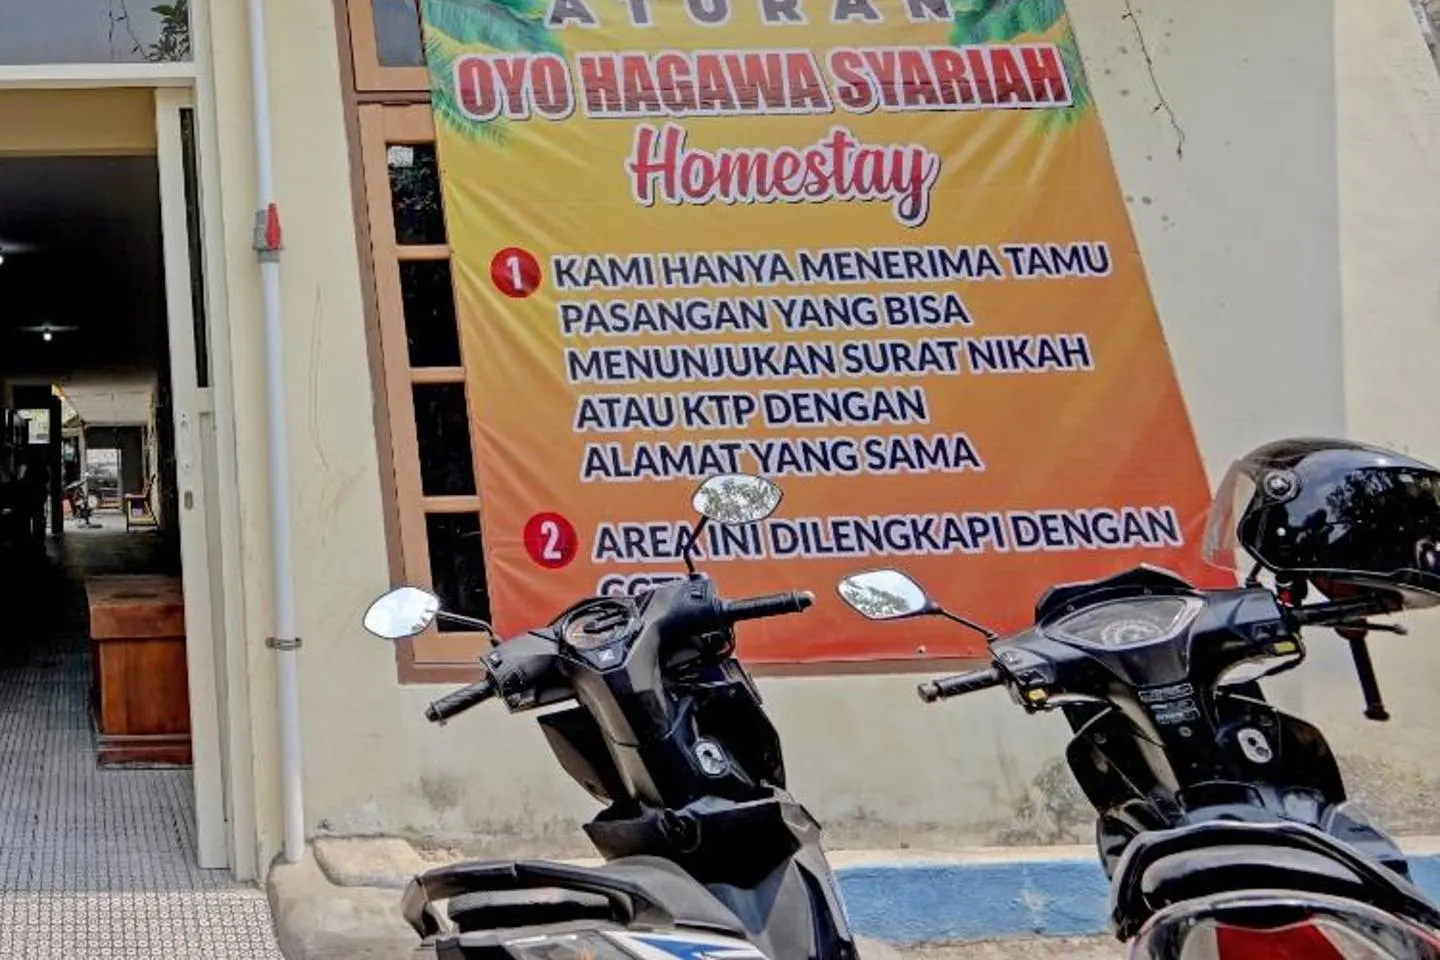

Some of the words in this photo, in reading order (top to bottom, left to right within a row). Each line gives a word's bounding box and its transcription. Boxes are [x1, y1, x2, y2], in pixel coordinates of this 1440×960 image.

[458, 54, 569, 116] OYO
[578, 51, 830, 113] HAGAWA
[829, 46, 1069, 109] SYARIAH
[629, 125, 936, 222] Homestay
[506, 255, 524, 291] 1
[554, 255, 655, 287] KAMI
[663, 252, 794, 285] HANYA
[799, 247, 1002, 282] MENERIMA
[1004, 243, 1110, 277] TAMU
[561, 298, 769, 333] PASANGAN
[773, 296, 878, 328] YANG
[884, 294, 971, 326] BISA
[567, 344, 834, 381] MENUNJUKAN
[843, 340, 959, 374] SURAT
[967, 336, 1090, 371] NIKAH
[576, 396, 674, 429] ATAU
[682, 394, 755, 425] KTP
[763, 388, 927, 425] DENGAN
[583, 442, 742, 478] ALAMAT
[750, 440, 858, 474] YANG
[865, 436, 981, 470] SAMA
[540, 520, 562, 561] 2
[596, 525, 701, 559] AREA
[711, 522, 761, 556] INI
[770, 512, 1004, 554] DILENGKAPI
[1012, 508, 1180, 548] DENGAN
